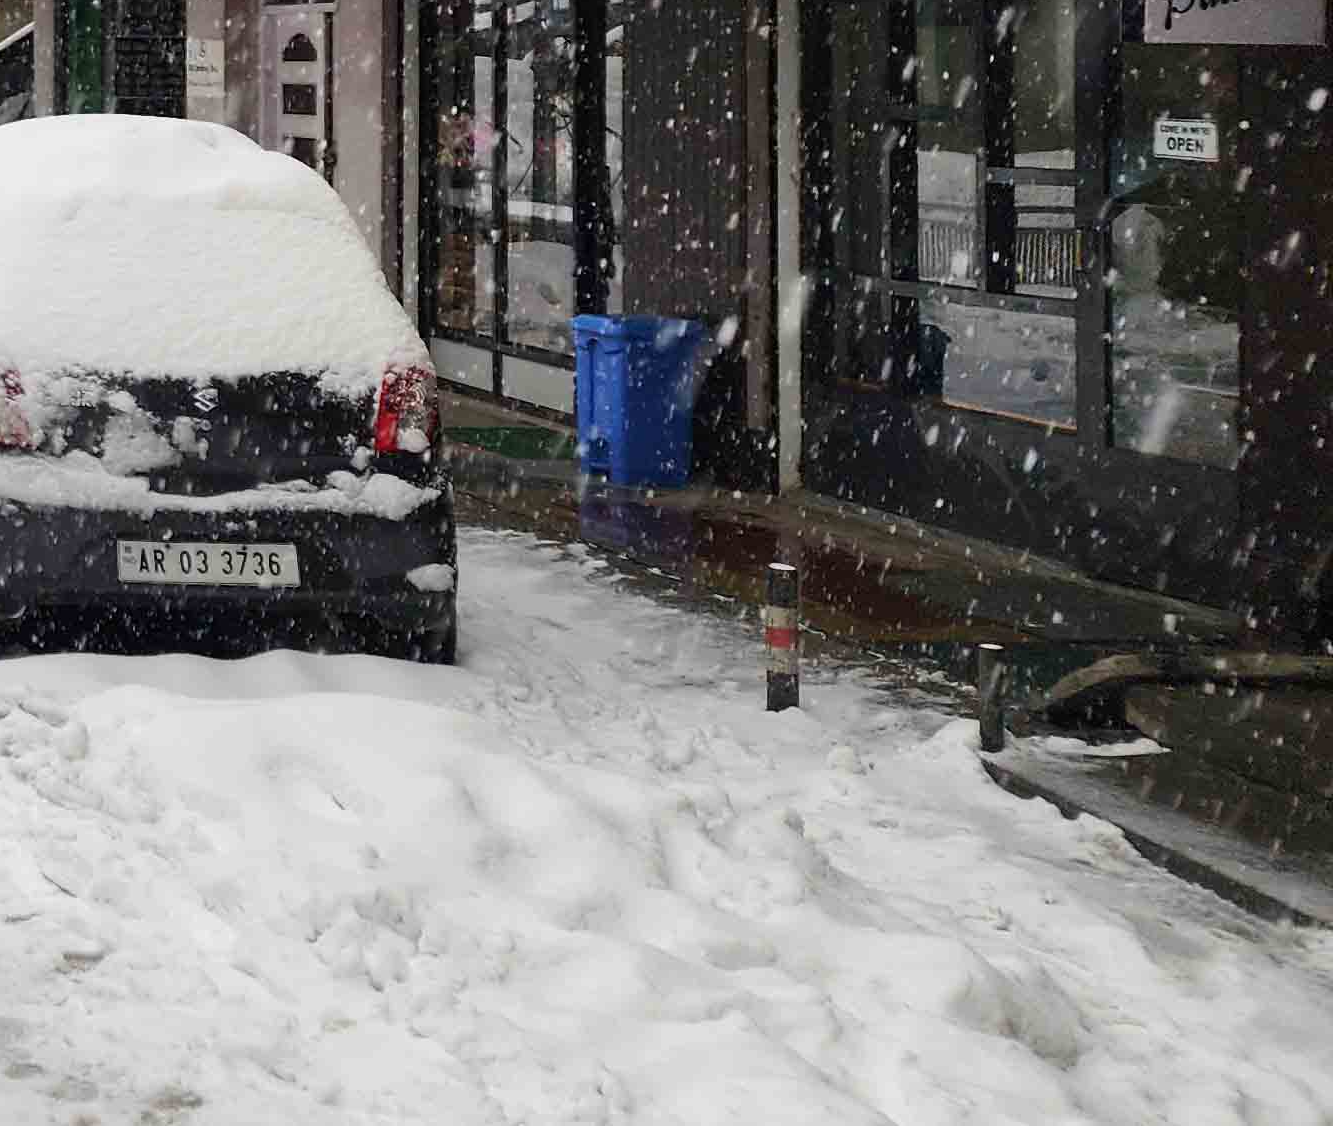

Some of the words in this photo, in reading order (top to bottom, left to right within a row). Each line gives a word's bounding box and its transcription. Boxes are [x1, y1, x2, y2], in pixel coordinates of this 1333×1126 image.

[1167, 137, 1204, 153] OPEN
[139, 547, 166, 574] AR
[180, 550, 209, 575] 03
[221, 551, 281, 576] 3736
